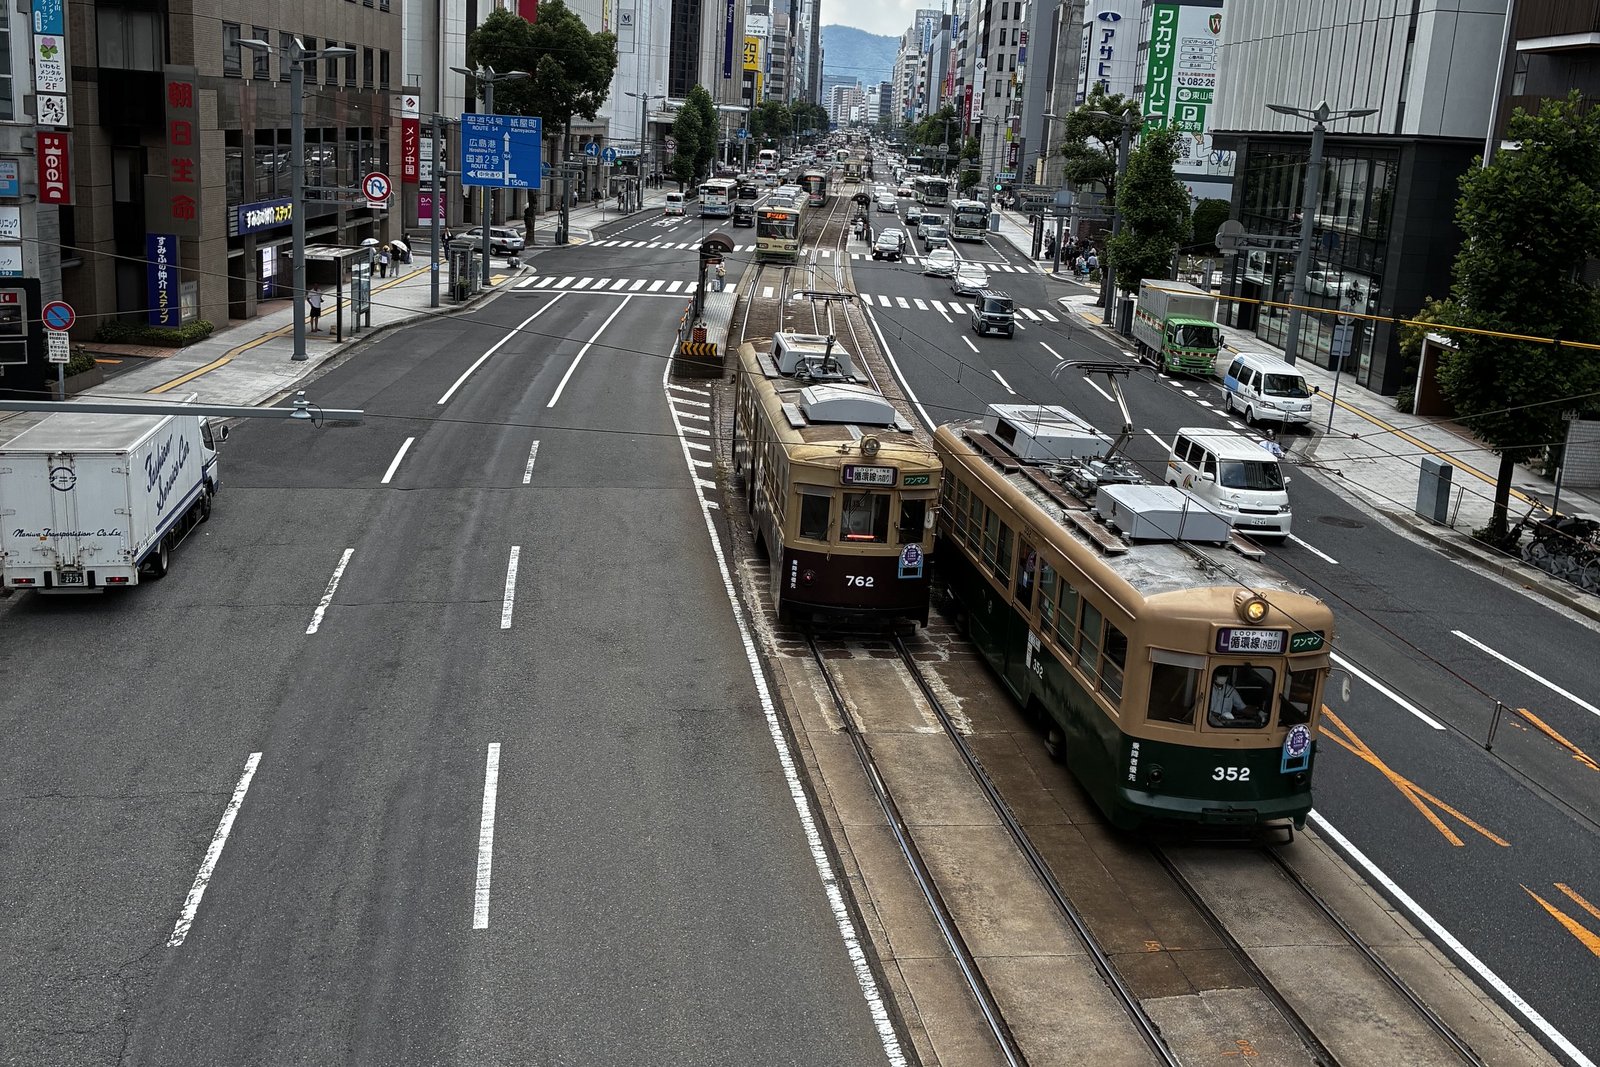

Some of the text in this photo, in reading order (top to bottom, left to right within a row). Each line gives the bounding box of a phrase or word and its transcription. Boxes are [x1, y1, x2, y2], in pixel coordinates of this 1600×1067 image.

[45, 82, 57, 90] 2F
[1185, 108, 1195, 119] P
[510, 118, 537, 129] 紙屋町
[468, 138, 496, 149] 広島港
[168, 81, 196, 222] 朝日生命
[405, 126, 415, 175] メイツ中国
[465, 154, 499, 165] 国道2号
[511, 179, 529, 187] 150m
[156, 236, 169, 324] すみふの仲介ステップ
[144, 433, 173, 493] Fashion
[156, 433, 190, 516] Service Car
[904, 476, 929, 485] ワンマン
[12, 528, 41, 538] Naniwa
[40, 527, 94, 540] Transportation
[845, 575, 874, 588] 762
[1293, 636, 1321, 648] ワンマン
[1032, 657, 1044, 680] 352
[1211, 766, 1251, 782] 352
